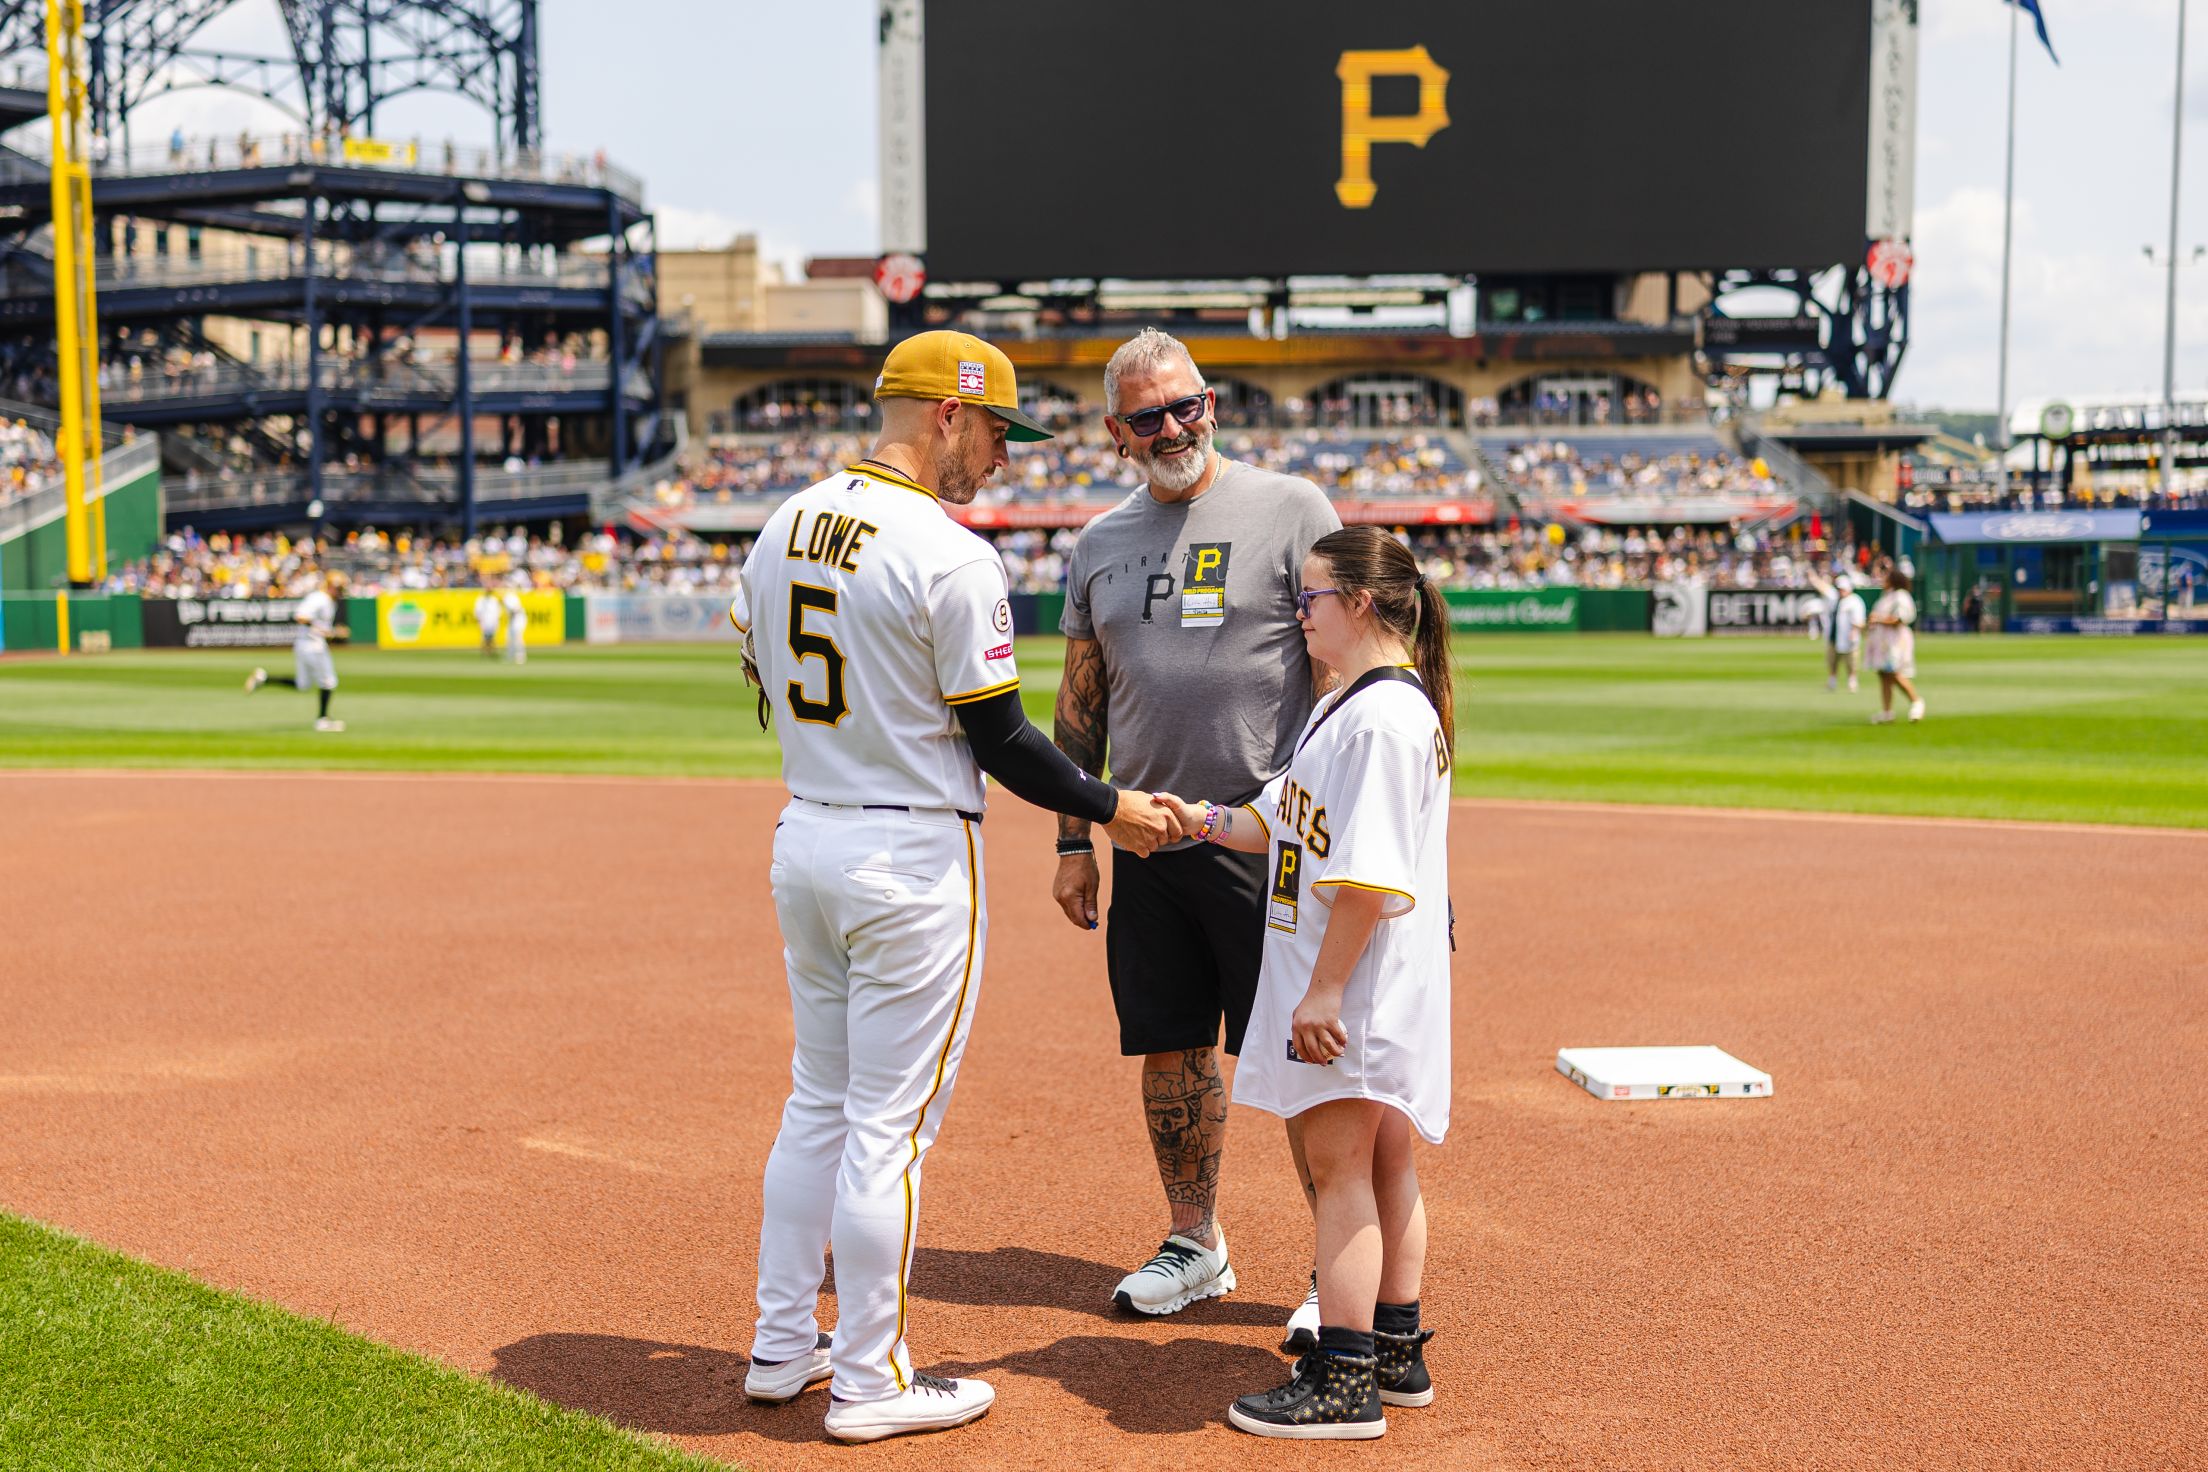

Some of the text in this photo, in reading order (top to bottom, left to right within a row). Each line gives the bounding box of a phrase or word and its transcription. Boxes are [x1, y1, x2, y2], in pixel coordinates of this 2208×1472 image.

[1334, 43, 1451, 208] P
[786, 509, 879, 575] LOWE
[1194, 548, 1222, 581] P
[1000, 604, 1008, 625] 9
[1142, 572, 1176, 620] P
[786, 581, 851, 728] 5
[1433, 726, 1450, 780] B
[1279, 849, 1297, 888] P
